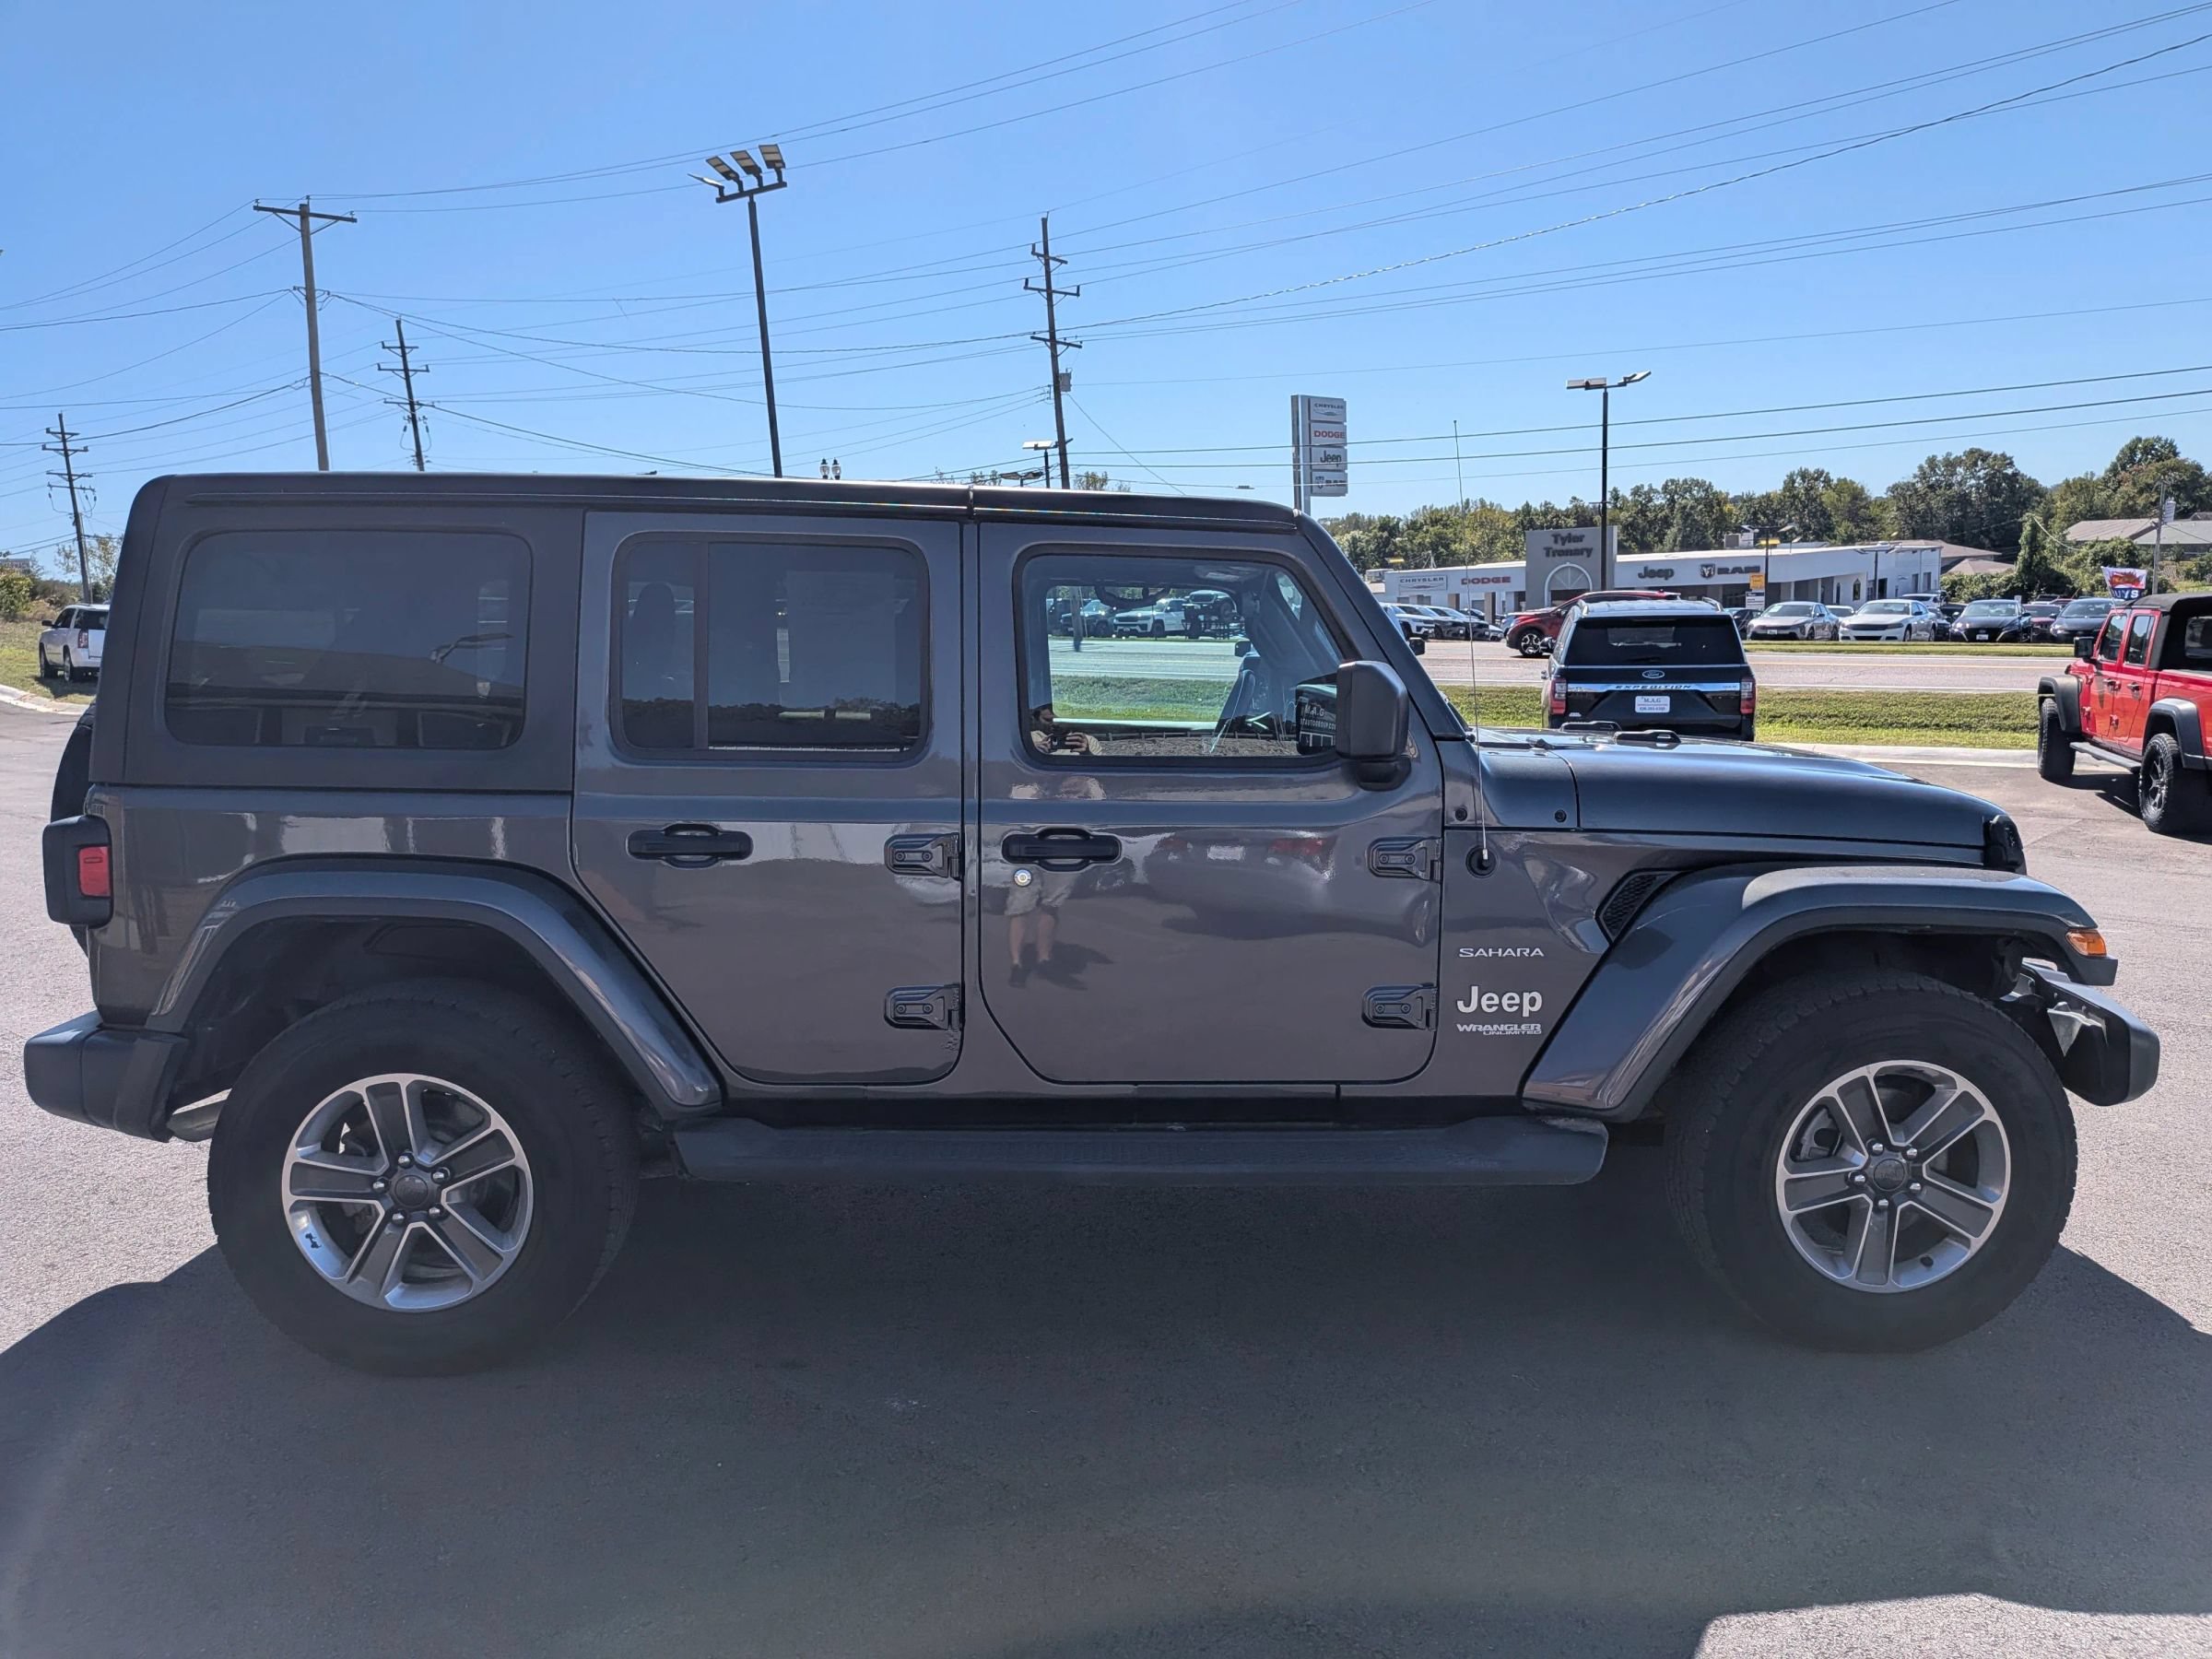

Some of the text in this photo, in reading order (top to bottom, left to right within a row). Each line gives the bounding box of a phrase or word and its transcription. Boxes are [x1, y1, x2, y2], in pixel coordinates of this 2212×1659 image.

[1313, 430, 1346, 439] DODGE
[1320, 450, 1342, 467] Jeep
[1551, 533, 1585, 546] Tyler
[1638, 566, 1675, 580] Jeep
[1717, 565, 1760, 575] RAM
[1461, 576, 1512, 585] DODGE
[1459, 947, 1545, 958] SAHARA
[1457, 985, 1543, 1018] Jeep
[1456, 1024, 1542, 1032] WRANGLER
